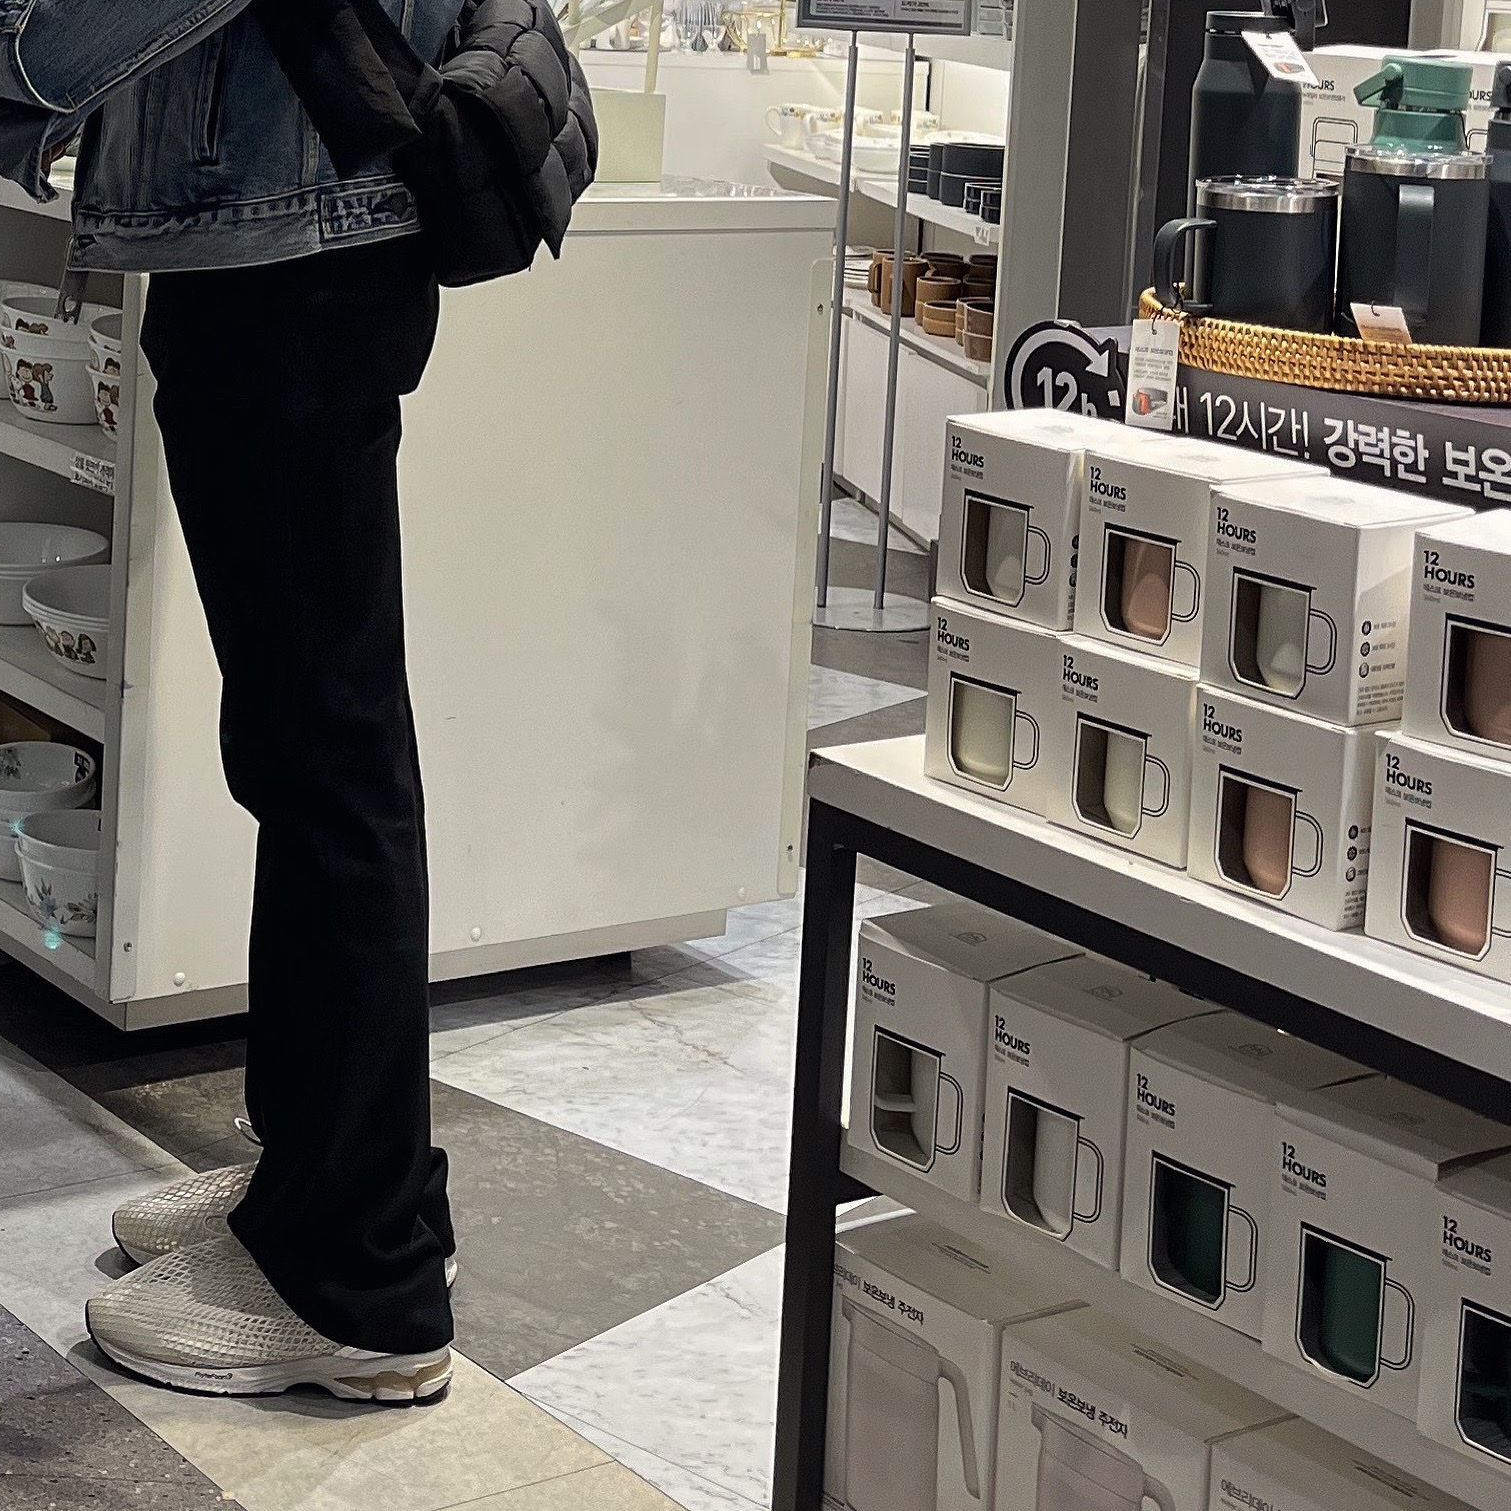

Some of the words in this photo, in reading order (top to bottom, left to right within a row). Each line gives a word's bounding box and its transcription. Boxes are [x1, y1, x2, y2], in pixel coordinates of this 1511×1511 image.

[951, 436, 962, 448] 12
[1199, 391, 1310, 460] 12시간!
[1323, 417, 1430, 485] 강력한
[951, 448, 985, 468] HOURS
[1090, 466, 1101, 481] 12
[1090, 480, 1127, 500] HOURS
[1217, 506, 1229, 522] 12
[1217, 521, 1257, 543] HOURS
[1423, 550, 1440, 566] 12
[1424, 565, 1475, 589] HOURS
[937, 616, 948, 631] 12
[937, 630, 970, 652] HOURS
[1062, 654, 1074, 670] 12
[1062, 668, 1099, 691] HOURS
[1203, 703, 1216, 719] 12
[1203, 718, 1243, 743] HOURS
[1385, 753, 1400, 771] 12
[1386, 767, 1433, 796] HOURS
[862, 957, 873, 973] 12
[862, 971, 896, 996] HOURS
[994, 1014, 1006, 1031] 12
[995, 1028, 1031, 1055] HOURS
[1136, 1073, 1149, 1091] 12
[1137, 1087, 1176, 1117] HOURS
[1281, 1141, 1296, 1160] 12
[1282, 1156, 1327, 1188] HOURS
[1443, 1215, 1458, 1234] 12
[1443, 1230, 1492, 1263] HOURS
[896, 1299, 925, 1326] 주전자
[1057, 1387, 1097, 1421] 보온보냉
[1098, 1409, 1129, 1439] 주전자
